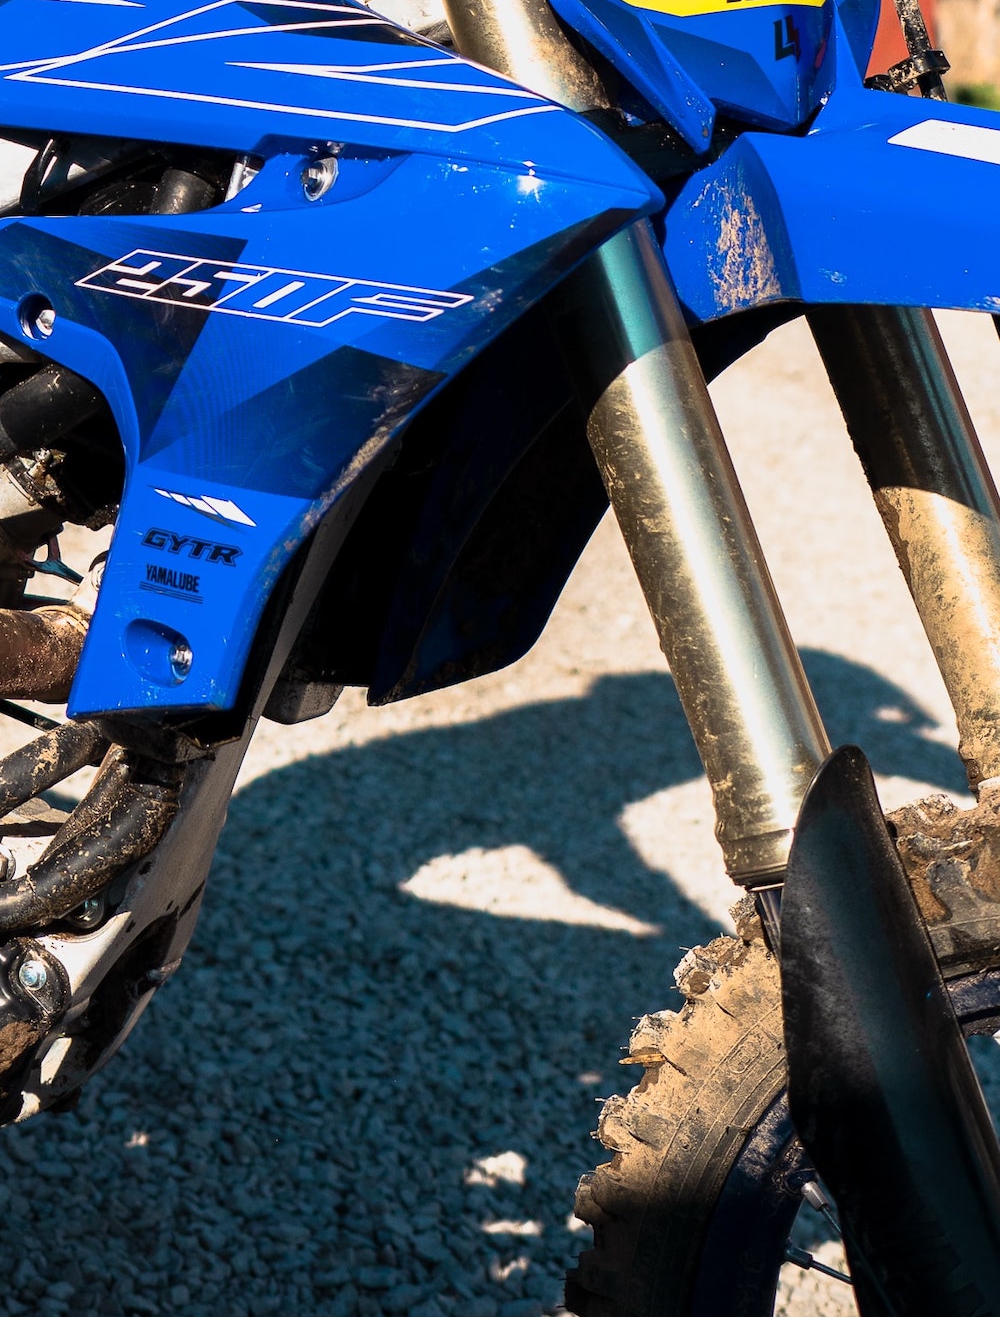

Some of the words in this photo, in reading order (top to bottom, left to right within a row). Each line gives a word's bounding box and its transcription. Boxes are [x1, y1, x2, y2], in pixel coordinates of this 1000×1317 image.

[73, 248, 475, 327] 250F
[142, 527, 244, 567] GYTR
[146, 563, 200, 593] YAMALUBE
